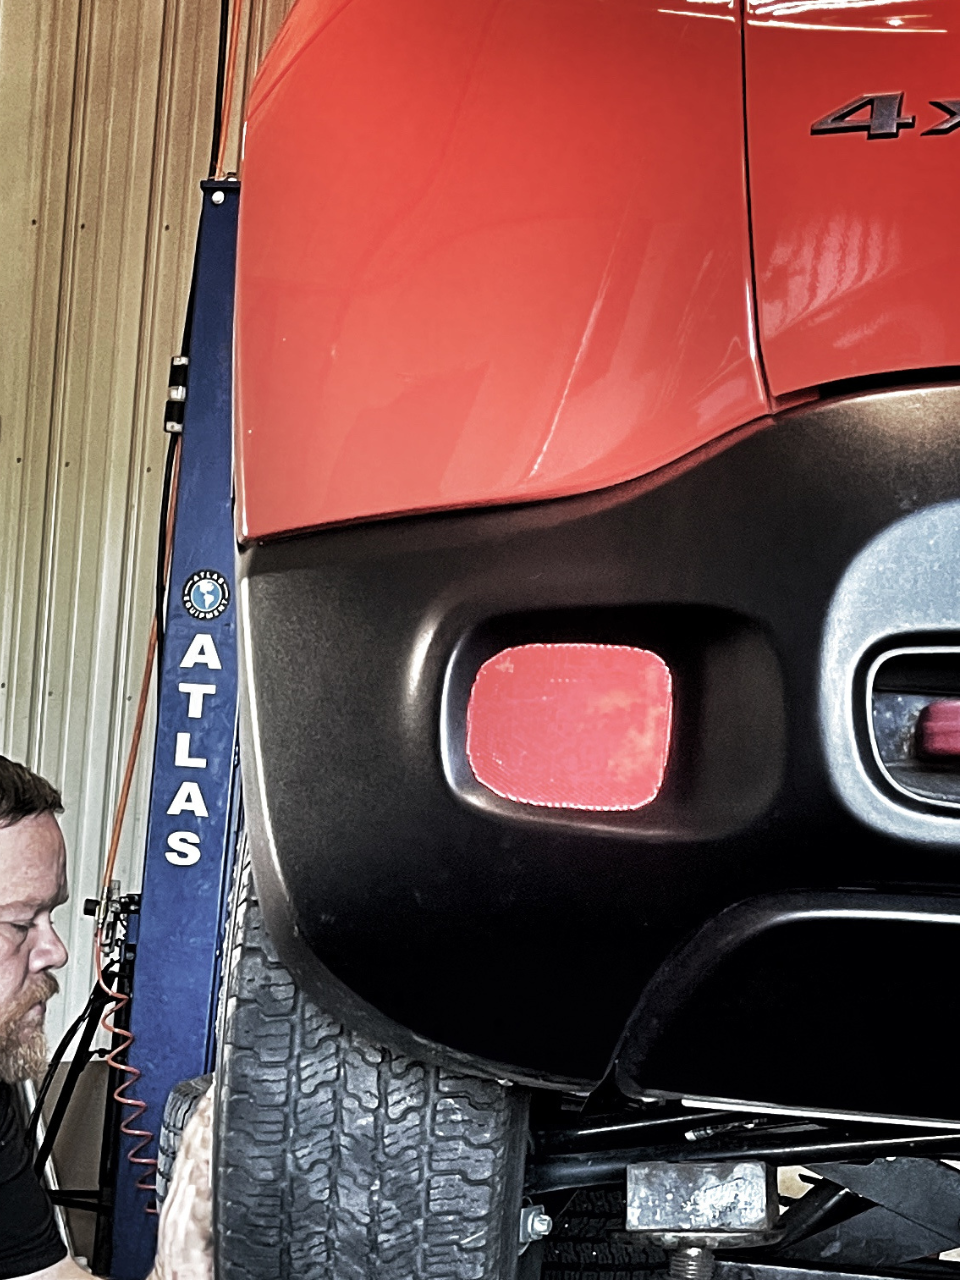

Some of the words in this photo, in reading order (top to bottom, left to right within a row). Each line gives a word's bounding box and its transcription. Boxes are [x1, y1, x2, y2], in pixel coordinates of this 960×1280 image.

[193, 571, 225, 585] ATLAS
[183, 596, 228, 619] EQUIPMENT
[165, 633, 222, 866] ATLAS
